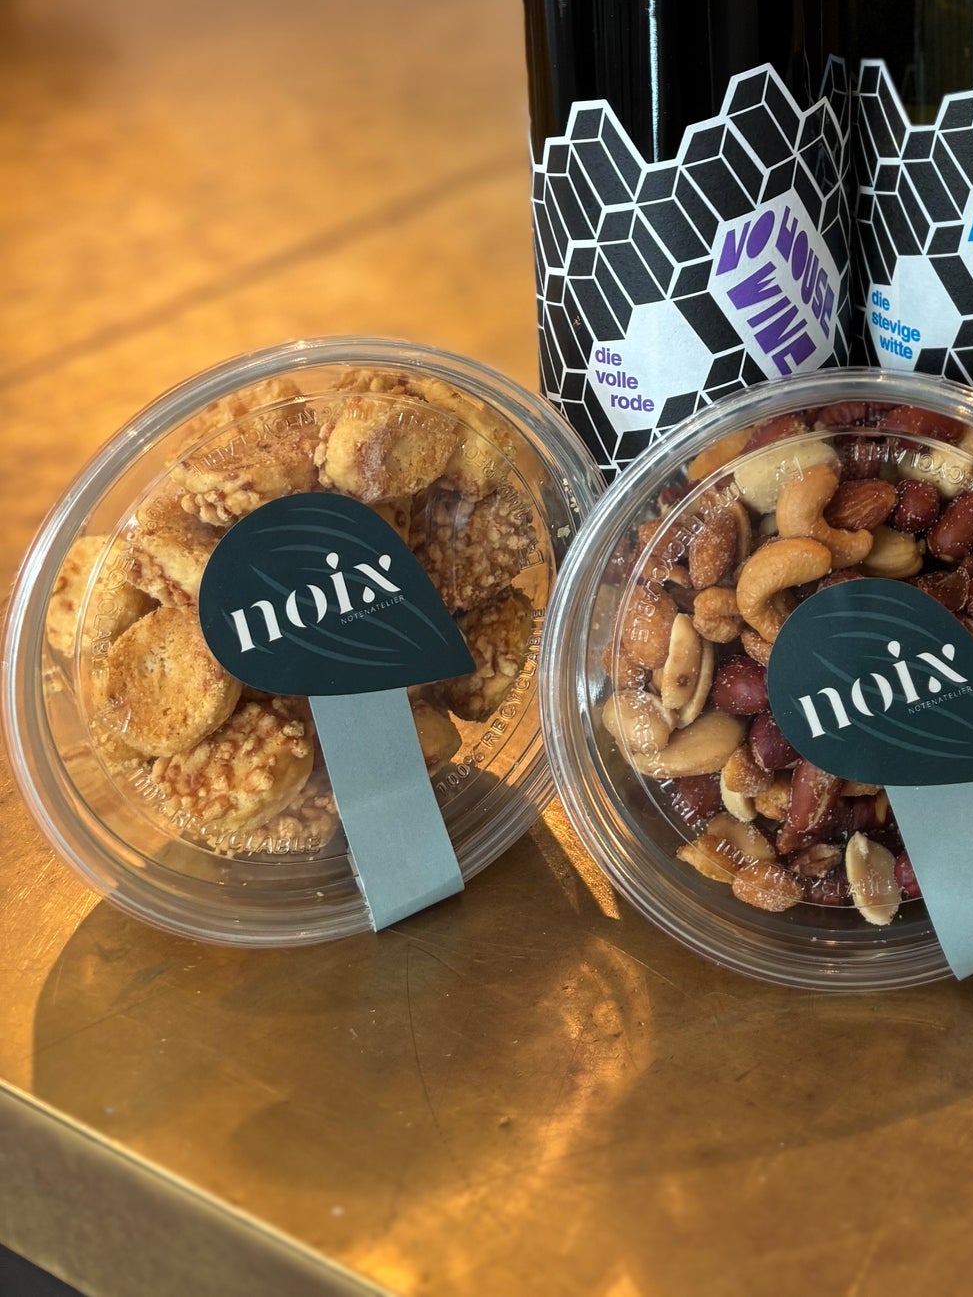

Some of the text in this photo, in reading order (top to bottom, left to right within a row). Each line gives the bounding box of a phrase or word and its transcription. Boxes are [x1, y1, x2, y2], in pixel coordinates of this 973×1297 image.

[775, 205, 835, 340] HOUSE
[872, 290, 890, 311] die
[726, 261, 818, 377] WINE
[871, 311, 921, 343] stevige
[595, 347, 622, 366] die
[879, 334, 913, 360] witte
[595, 370, 639, 389] volle
[611, 394, 655, 412] rode
[230, 552, 402, 653] noix
[340, 594, 406, 625] NOTENATELIER
[798, 640, 969, 739] noix
[907, 685, 973, 716] NOTENATELIER
